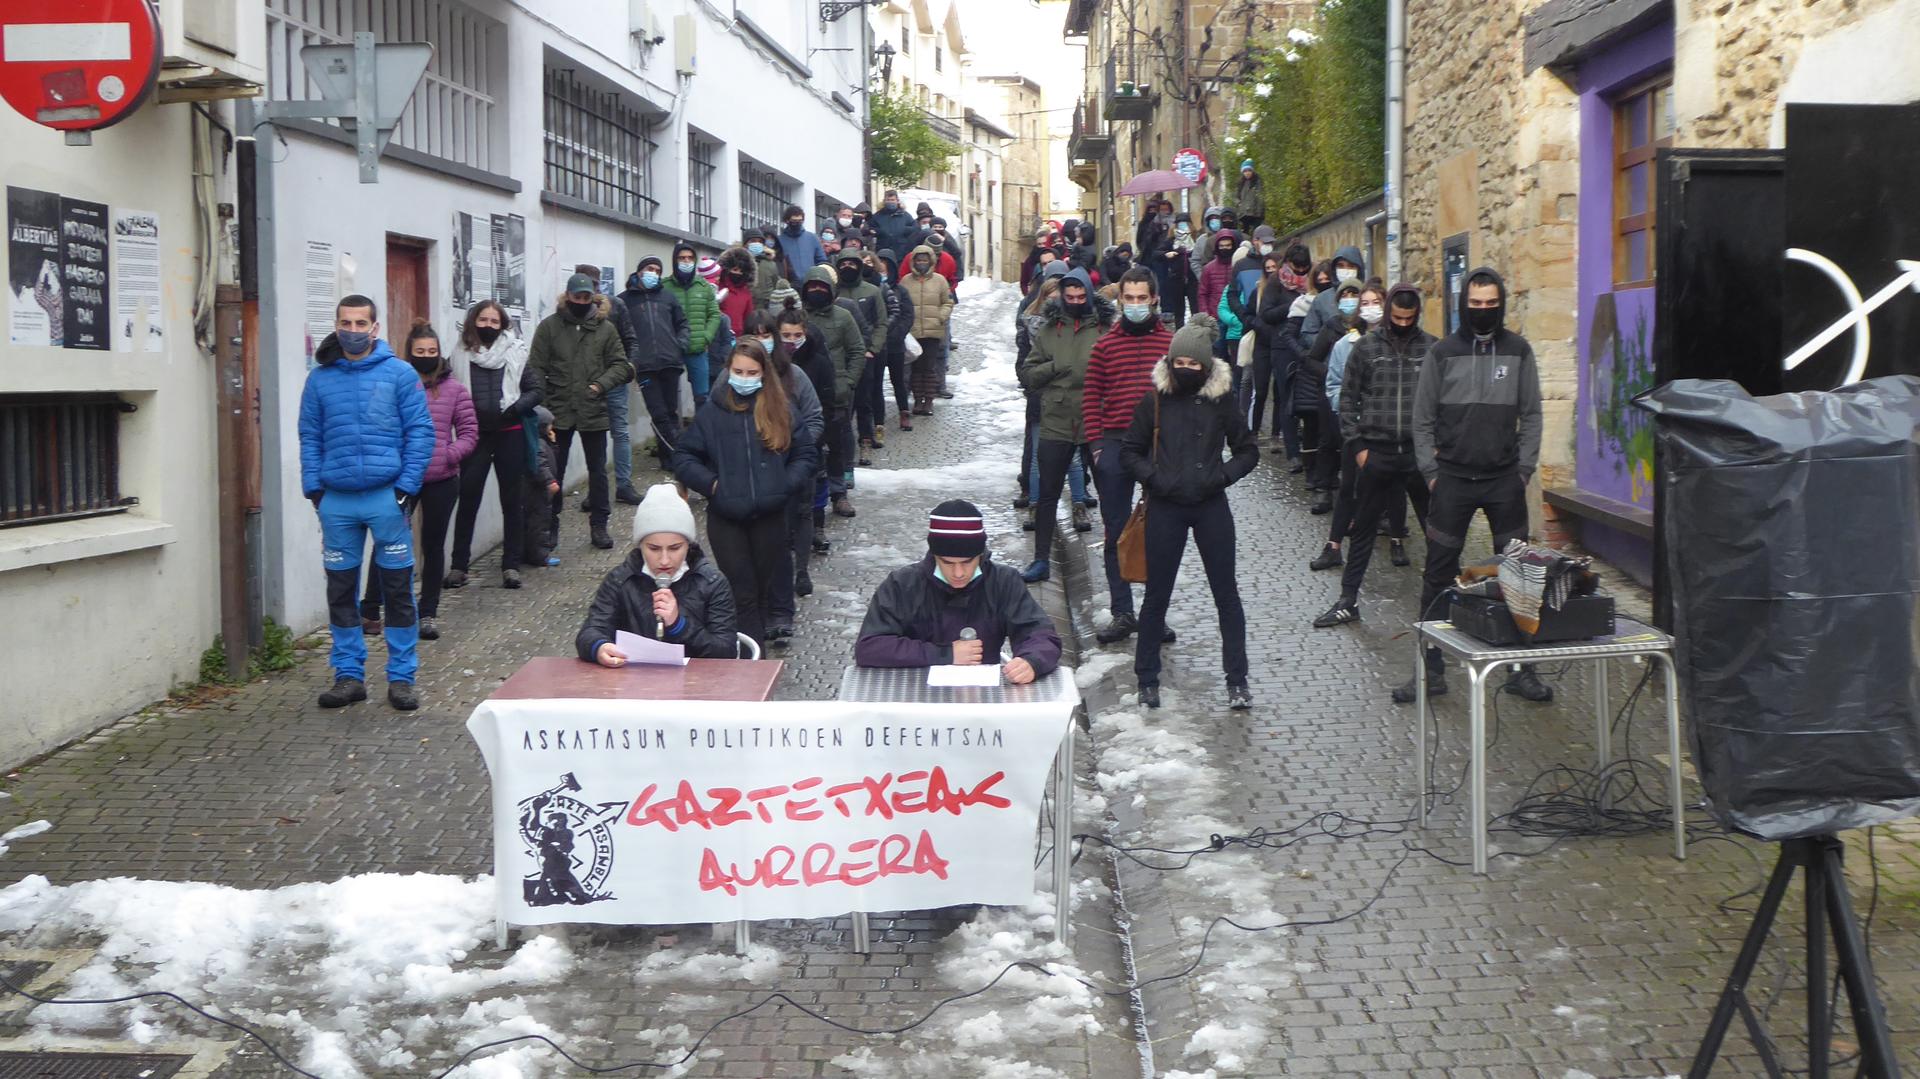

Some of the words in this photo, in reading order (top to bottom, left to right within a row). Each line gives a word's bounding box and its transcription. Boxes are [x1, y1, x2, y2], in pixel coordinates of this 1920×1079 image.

[523, 728, 666, 751] ASKATASUN
[690, 727, 842, 749] POLITIKOEN
[865, 726, 1003, 748] DEFENTSAN
[550, 797, 591, 820] AZTE
[627, 766, 1011, 832] GAZTETXEAK
[700, 829, 949, 895] AURRERA
